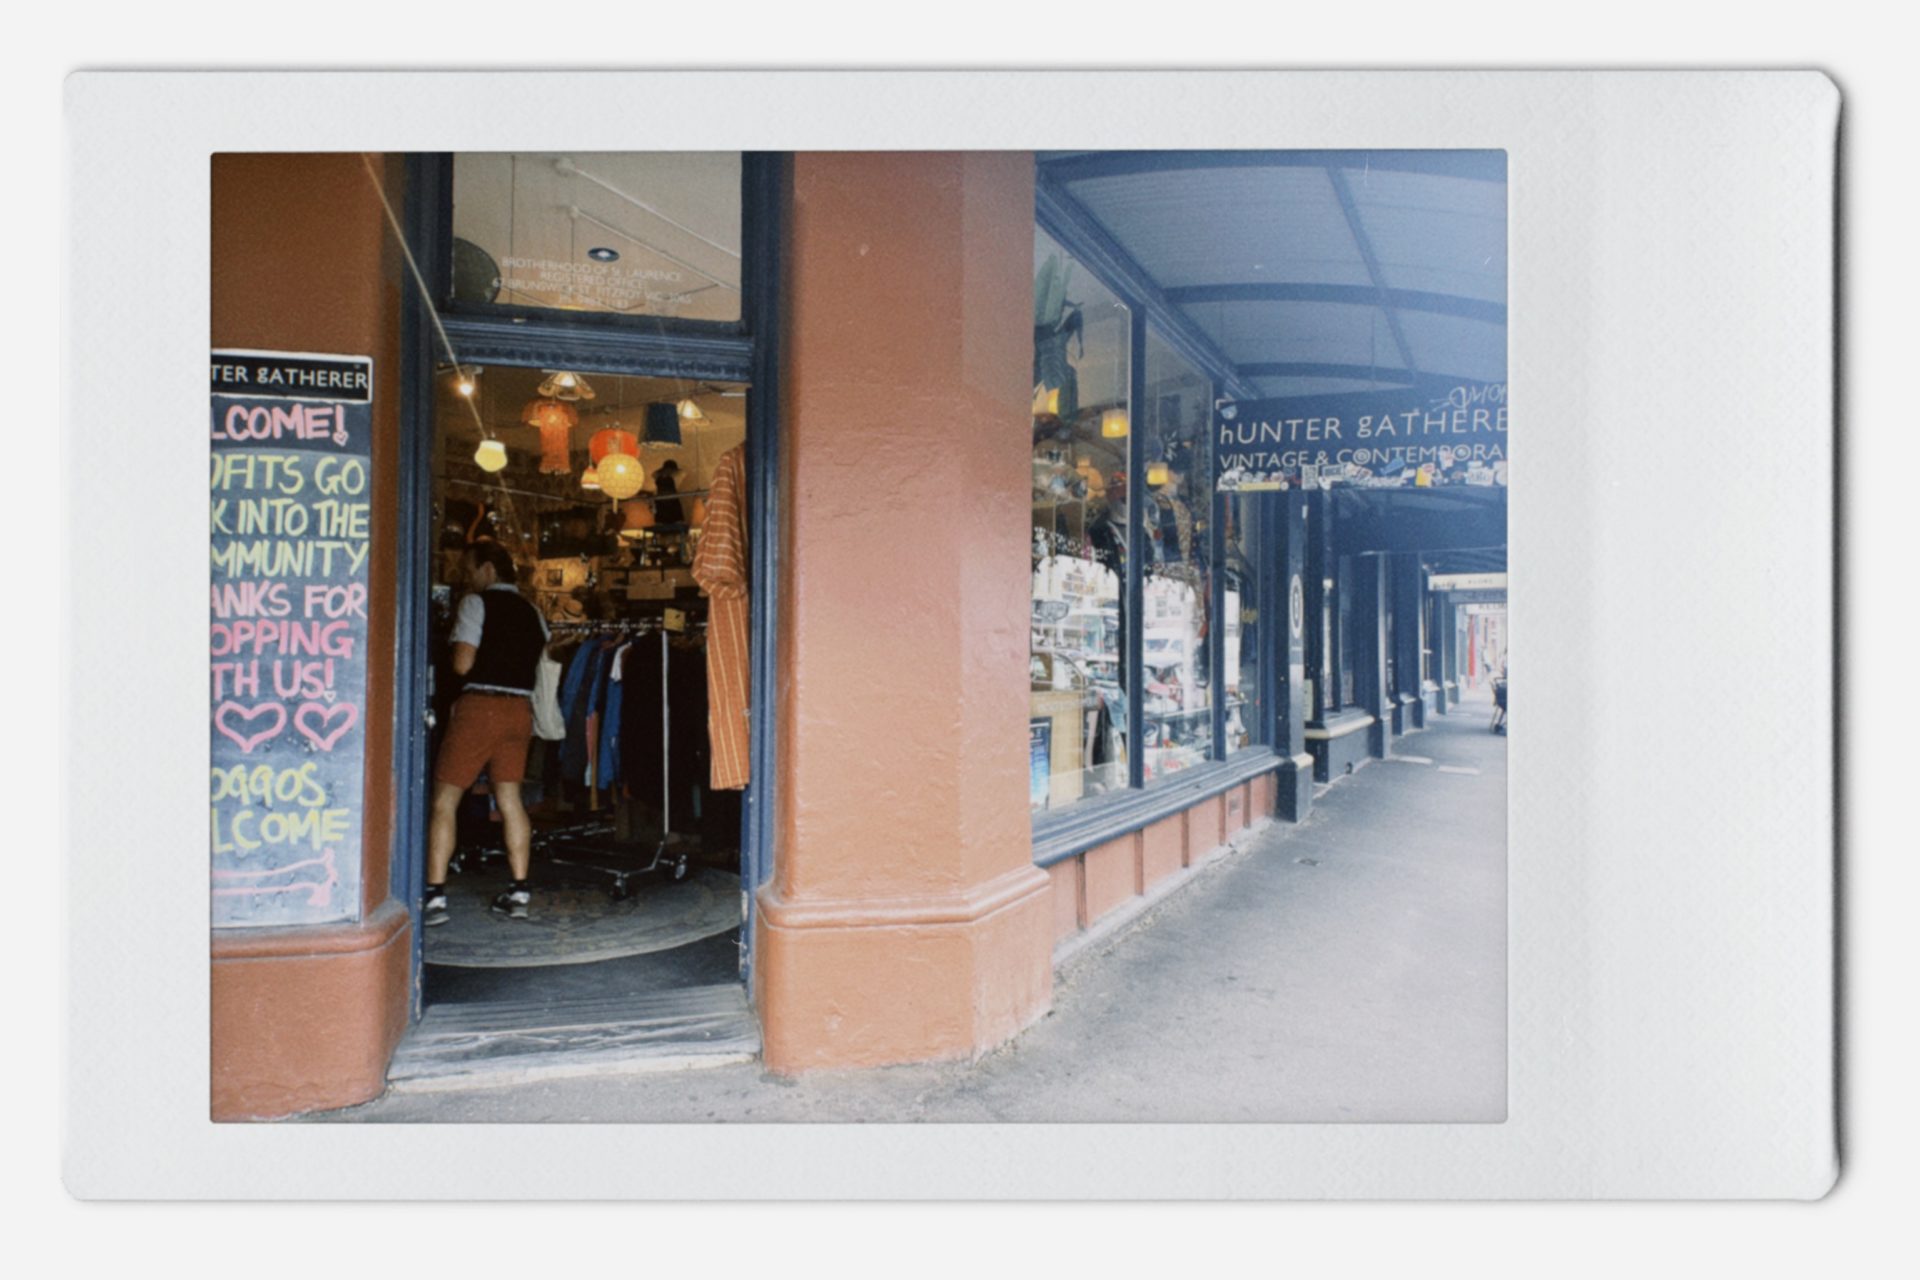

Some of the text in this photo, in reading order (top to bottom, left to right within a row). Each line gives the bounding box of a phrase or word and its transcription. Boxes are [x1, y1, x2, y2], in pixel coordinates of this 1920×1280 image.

[211, 364, 249, 383] TER
[314, 455, 366, 496] GO
[1219, 450, 1309, 470] VINTAGE
[211, 497, 370, 538] K INTO THE
[304, 582, 368, 619] FOR
[211, 619, 354, 660] OPPING
[211, 658, 336, 703] TH US!
[211, 807, 350, 855] LCOME
